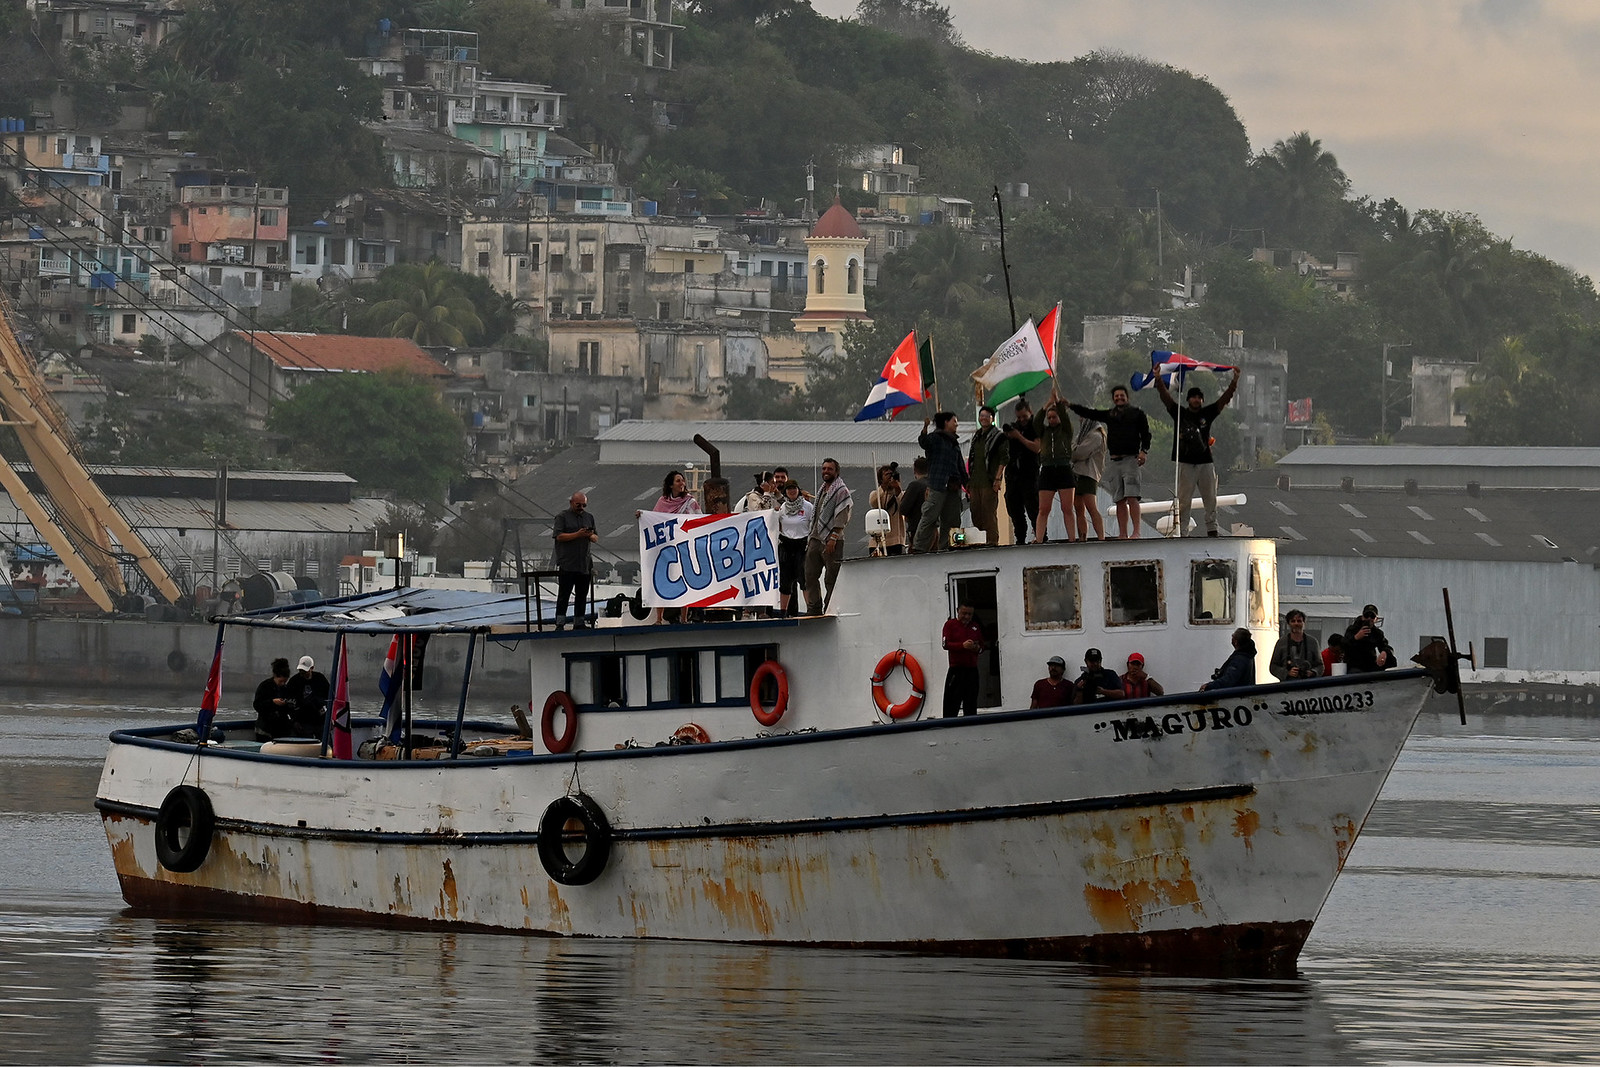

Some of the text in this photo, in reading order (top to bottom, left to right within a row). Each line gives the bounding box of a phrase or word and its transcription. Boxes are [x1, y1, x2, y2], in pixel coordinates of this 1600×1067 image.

[643, 518, 679, 550] LET
[653, 516, 776, 600] CUBA
[741, 566, 779, 599] LIVE
[1279, 690, 1375, 717] 31012100233
